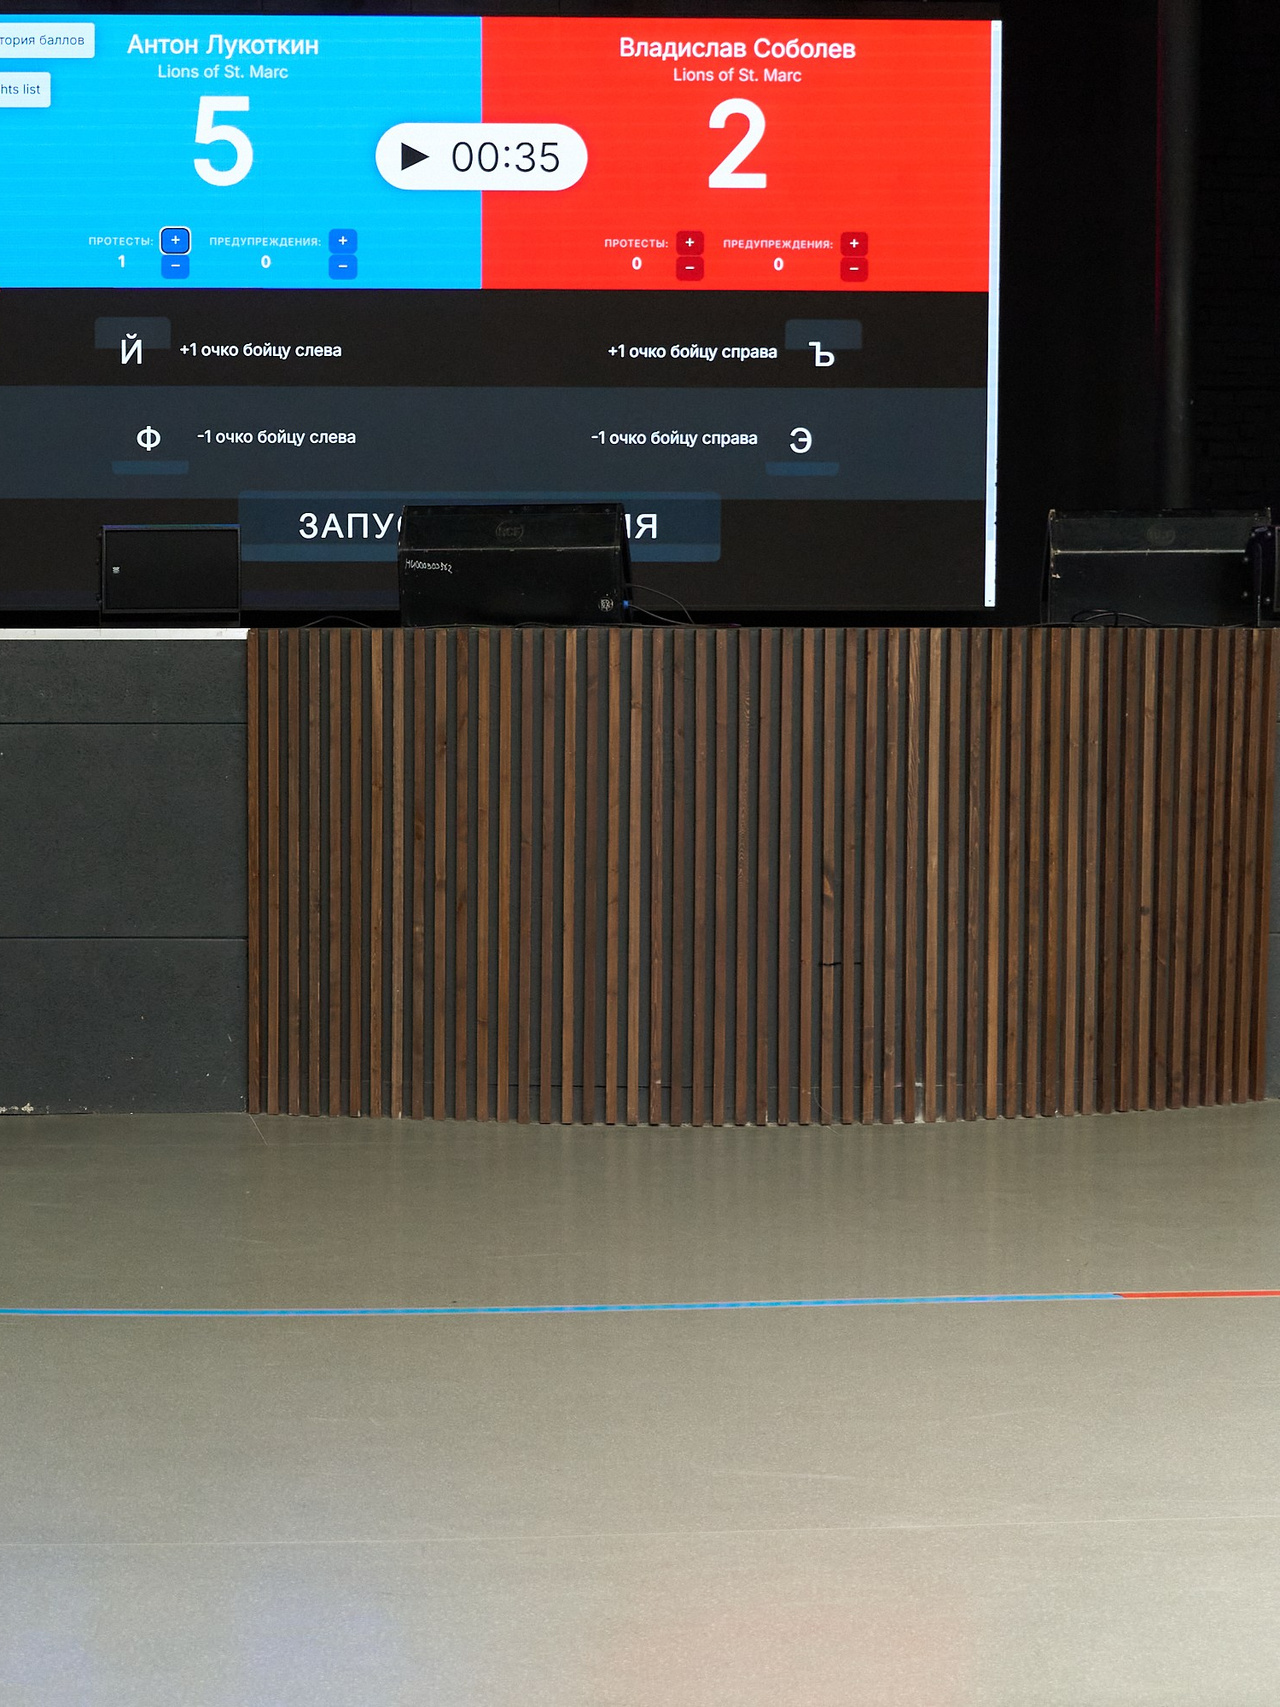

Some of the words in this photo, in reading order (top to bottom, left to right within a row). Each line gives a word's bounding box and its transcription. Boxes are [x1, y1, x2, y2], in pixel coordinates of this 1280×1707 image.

[39, 35, 85, 46] баллов
[126, 34, 199, 55] Антон
[206, 34, 319, 60] Лукоткин
[619, 37, 748, 62] Владислав
[753, 37, 857, 59] Соболев
[157, 64, 200, 79] Lions
[203, 64, 220, 79] of
[223, 64, 245, 79] St.
[249, 65, 289, 80] Marc
[673, 67, 715, 82] Lions
[718, 67, 735, 82] of
[738, 67, 759, 82] St.
[763, 68, 802, 83] Marc
[23, 83, 41, 95] list
[193, 95, 254, 187] 5
[708, 97, 767, 189] 2
[452, 141, 561, 173] 00:35
[88, 236, 154, 247] ПРОТЕСТЫ:
[209, 236, 322, 248] ПРЕДУПРЕЖДЕНИЯ:
[604, 238, 669, 249] ПРОТЕСТЫ:
[723, 239, 833, 250] ПРЕДУПРЕЖДЕНИЯ:
[117, 254, 125, 268] 1
[260, 254, 272, 269] 0
[631, 256, 643, 271] 0
[773, 257, 784, 272] 0
[121, 332, 143, 365] Й
[179, 342, 197, 357] +1
[200, 345, 239, 357] очко
[242, 342, 292, 360] бойцу
[294, 345, 342, 358] слева
[607, 343, 625, 358] +1
[629, 346, 667, 359] очко
[670, 343, 719, 362] бойцу
[721, 347, 778, 362] справа
[808, 341, 835, 367] Ъ
[136, 425, 161, 452] Ф
[197, 429, 211, 444] -1
[215, 432, 254, 444] очко
[257, 429, 306, 447] бойцу
[309, 432, 356, 444] слева
[591, 430, 605, 445] -1
[609, 433, 647, 445] очко
[650, 430, 699, 448] бойцу
[701, 433, 758, 448] справа
[789, 427, 813, 454] Э
[299, 512, 403, 539] ЗАПУ
